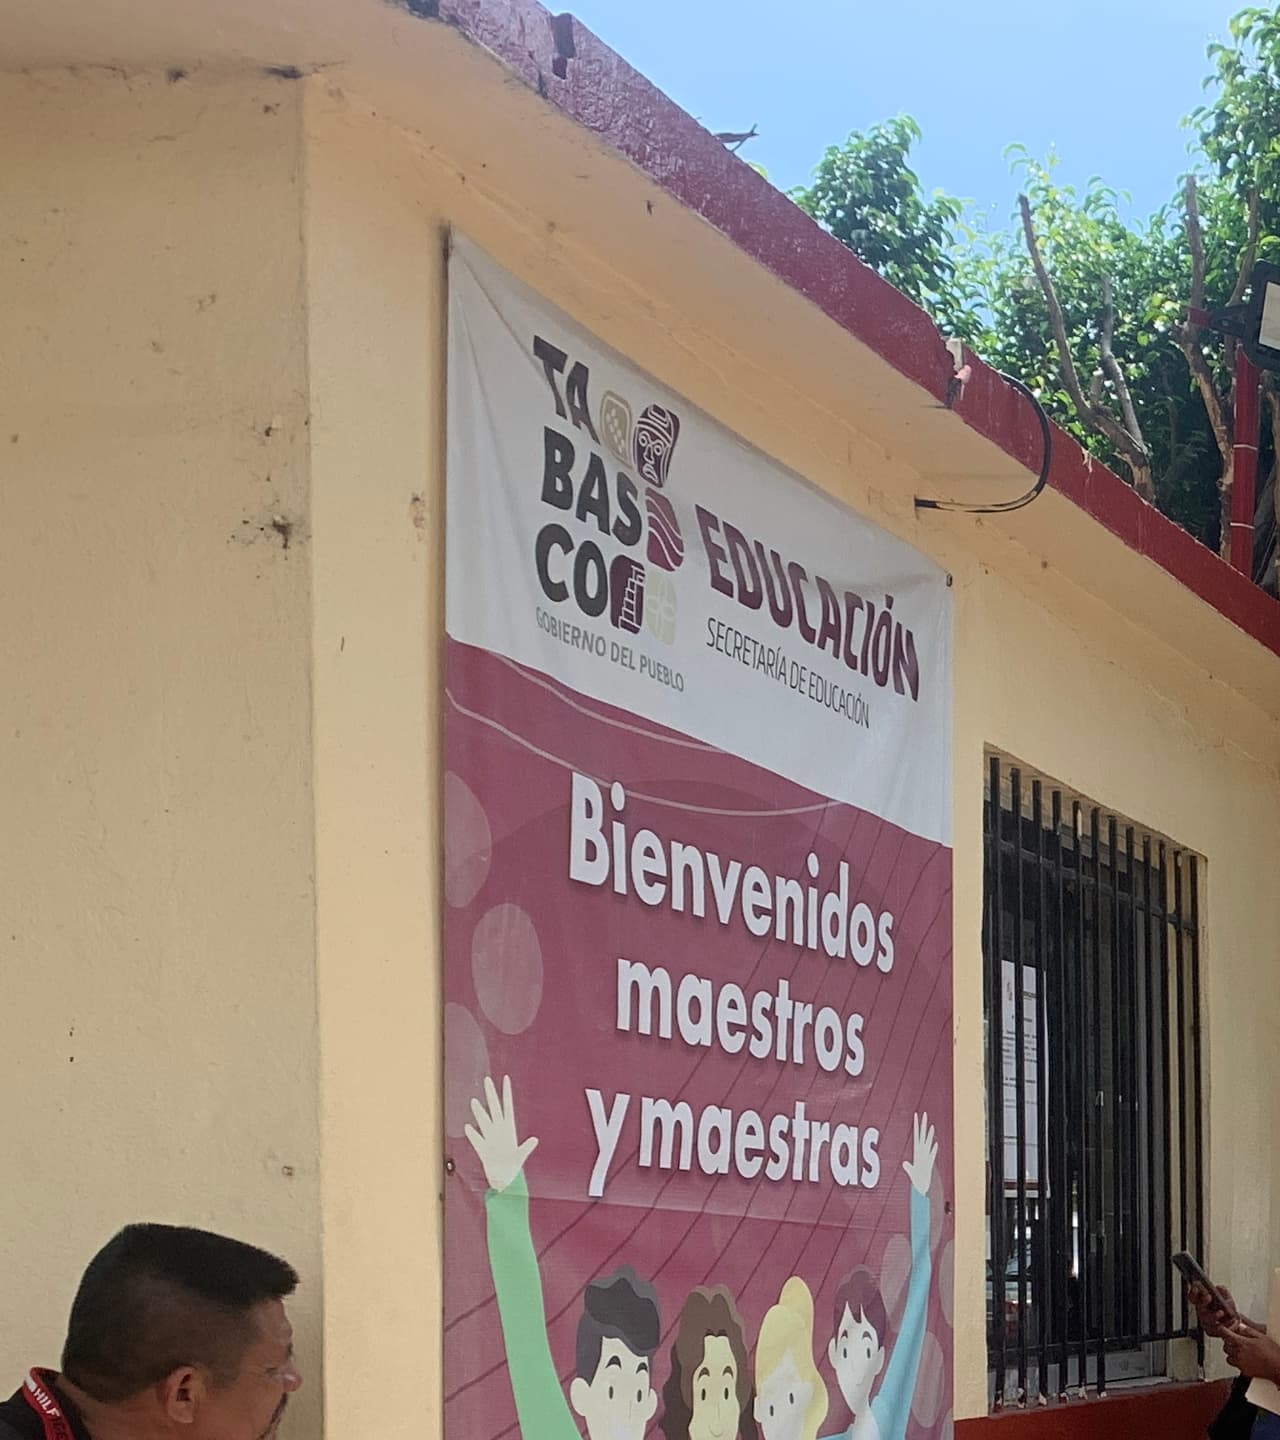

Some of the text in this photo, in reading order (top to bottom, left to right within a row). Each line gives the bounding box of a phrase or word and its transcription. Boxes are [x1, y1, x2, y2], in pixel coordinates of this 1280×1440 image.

[533, 335, 601, 447] TA
[541, 426, 643, 546] BAS
[535, 523, 609, 618] CO
[695, 504, 920, 702] EDUCACIÓN
[535, 606, 685, 693] GOBIERNO DEL PUEBLO
[706, 617, 870, 729] SECRETARÍA DE EDUCACIÓN
[569, 771, 895, 974] Bienvenidos
[616, 958, 865, 1077] maestros
[585, 1088, 881, 1197] y maestras
